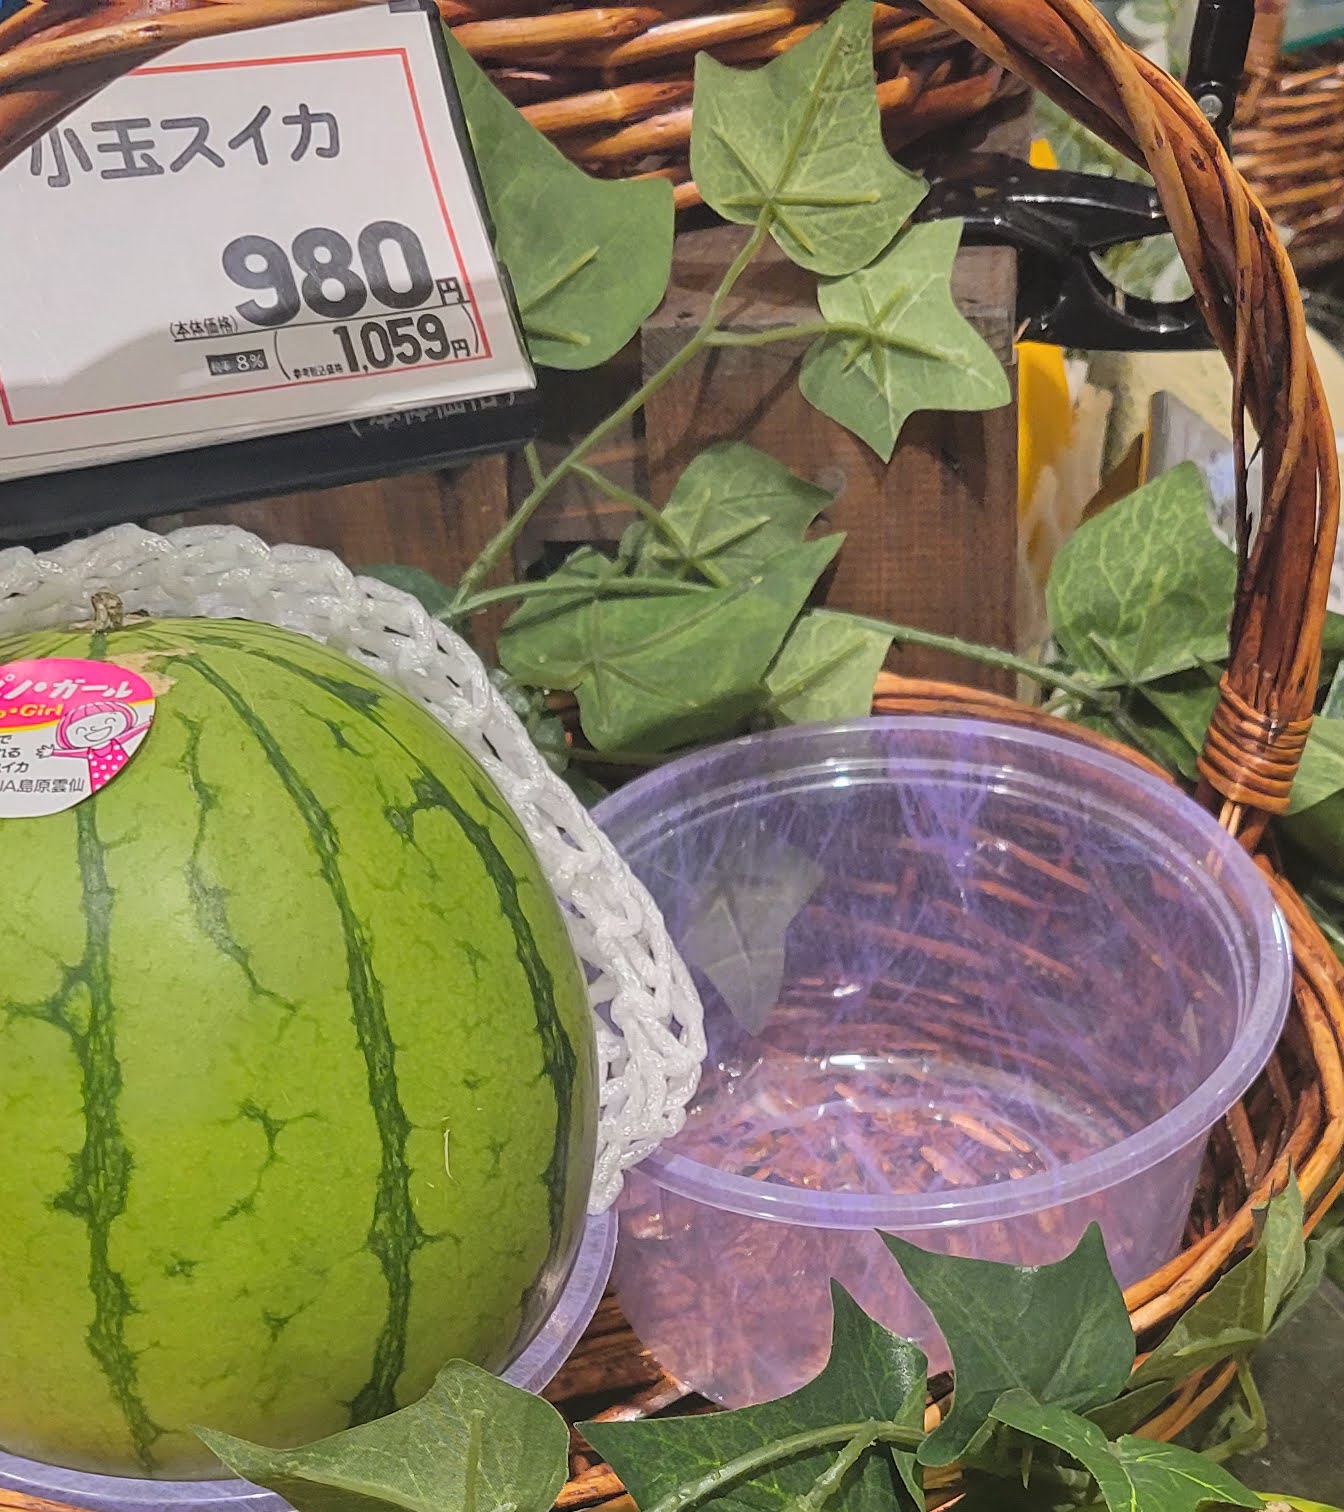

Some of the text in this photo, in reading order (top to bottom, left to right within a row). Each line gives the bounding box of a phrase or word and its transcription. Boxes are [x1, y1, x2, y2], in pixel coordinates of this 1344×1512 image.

[30, 104, 339, 187] 小玉スイカ
